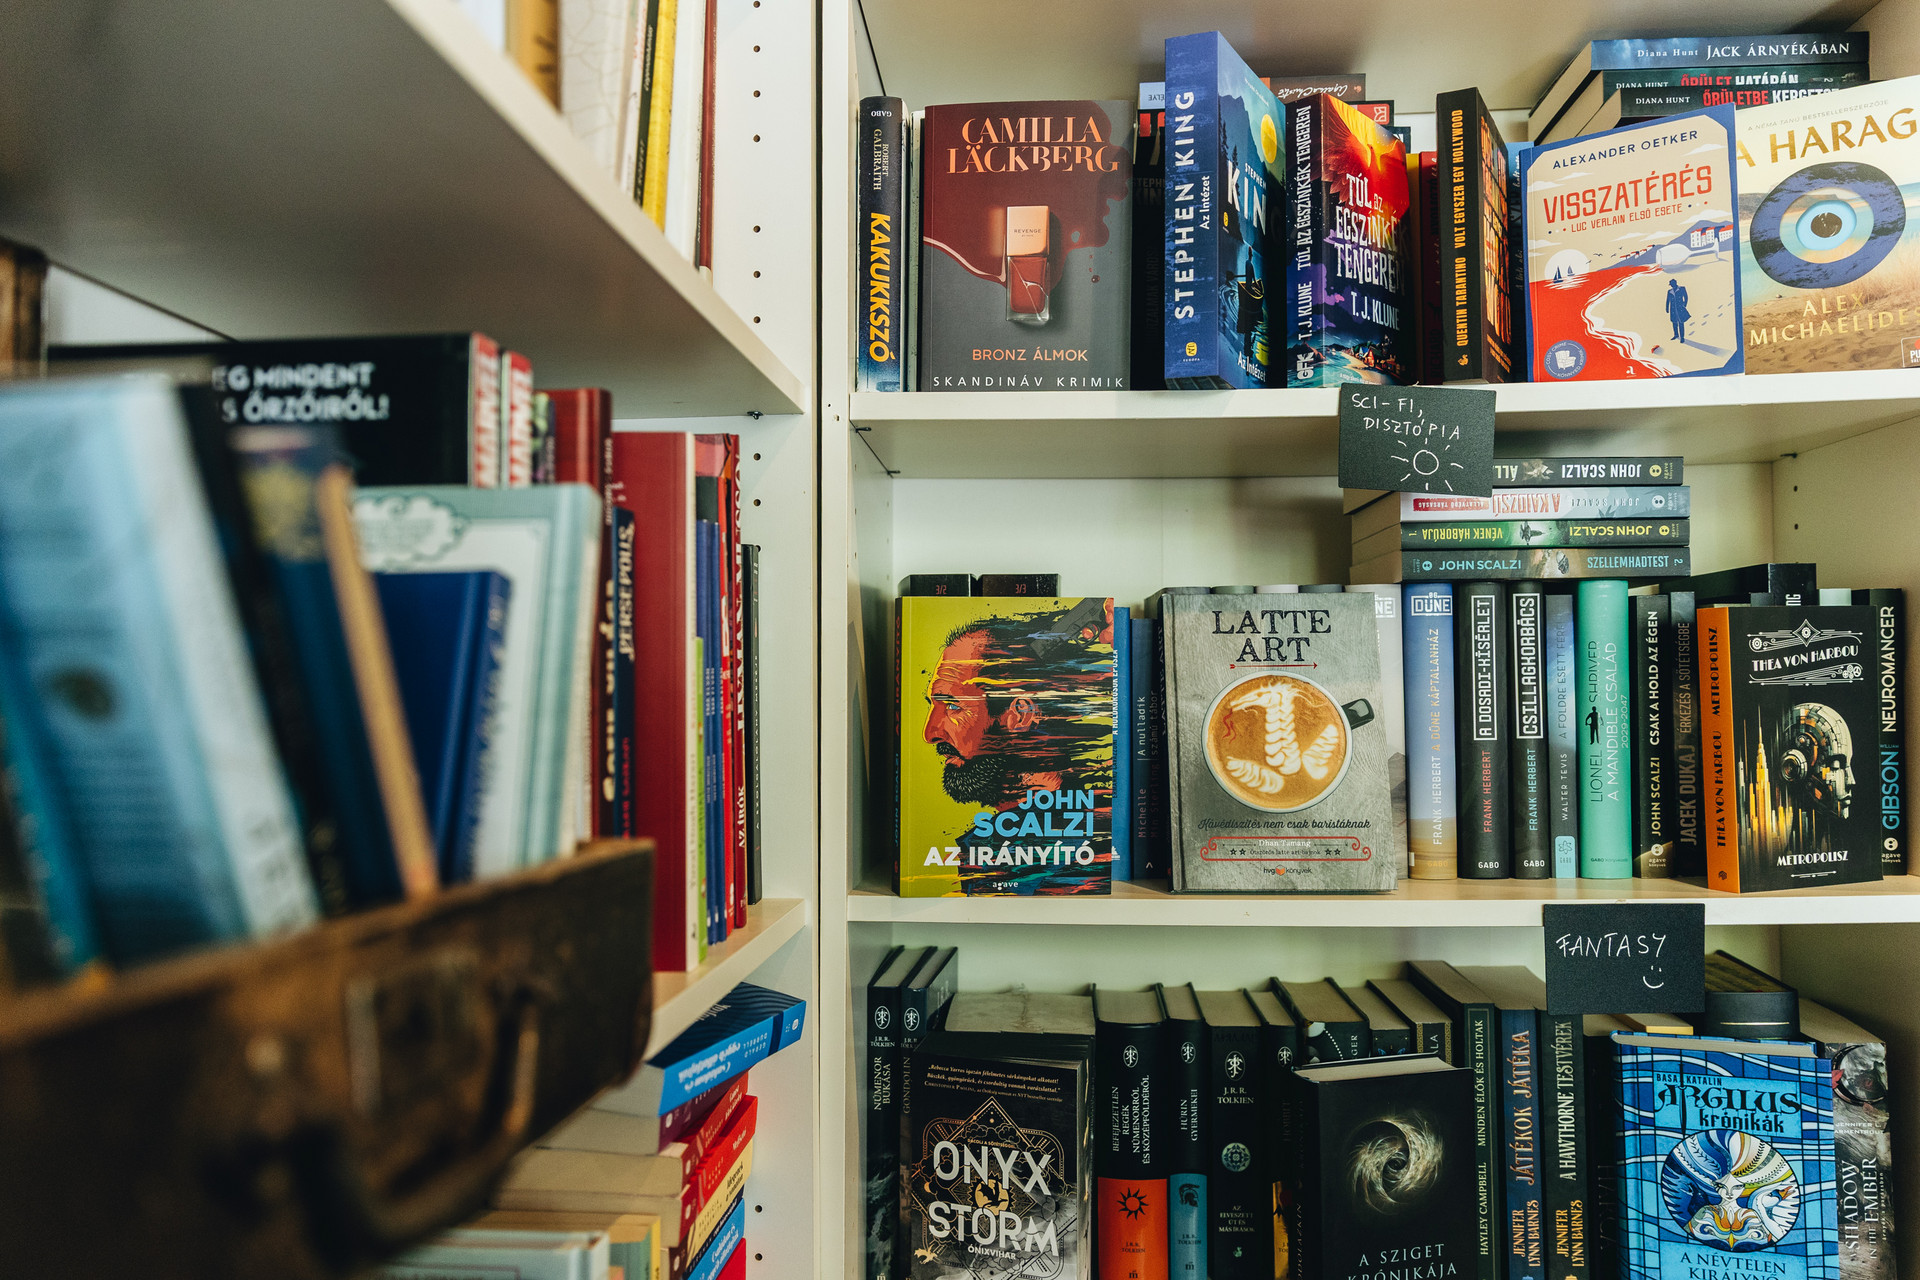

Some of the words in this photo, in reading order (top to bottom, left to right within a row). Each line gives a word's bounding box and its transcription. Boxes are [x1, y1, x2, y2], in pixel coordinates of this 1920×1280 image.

[1637, 50, 1668, 58] Diana
[1673, 48, 1699, 56] Hunt
[1706, 44, 1741, 61] JACK
[1747, 41, 1850, 57] ÁRNYÉKÁBAN
[1665, 96, 1690, 104] HUNT
[961, 116, 1103, 143] CAMILLA
[1174, 91, 1194, 167] KING
[1296, 105, 1312, 163] TENGEREN
[1451, 109, 1464, 163] HOLLYWOOD
[1769, 107, 1918, 164] HARAG
[873, 129, 882, 190] GALBRAITH
[947, 142, 1120, 173] LÄCKBERG
[1552, 142, 1636, 170] ALEXANDER
[1642, 129, 1698, 152] OETKER
[1346, 173, 1372, 208] TÚL
[1453, 165, 1464, 183] EGY
[1199, 175, 1210, 212] Intézet
[1294, 163, 1312, 229] ÉGSZÍNKÉK
[1453, 185, 1465, 224] EGYSZER
[1543, 163, 1713, 224] VISSZATÉRÉS
[1200, 213, 1210, 230] Az
[1571, 220, 1588, 233] LUC
[1590, 213, 1626, 230] VERLAIN
[1655, 202, 1683, 218] ESETE
[1174, 183, 1194, 319] STEPHEN
[1454, 225, 1466, 248] VOLT
[1296, 247, 1312, 270] TÚL
[870, 212, 895, 362] KAKUKKSZÓ
[1298, 281, 1312, 315] KLUNE
[1455, 257, 1467, 306] TARANTINO
[1372, 299, 1400, 331] KLUNE
[1803, 292, 1864, 317] ALEX
[1456, 308, 1468, 346] QUENTIN
[1750, 306, 1920, 346] MICHAELIDES
[972, 348, 1027, 361] BRONZ
[1034, 346, 1088, 362] ÁLMOK
[253, 362, 375, 388] MINDENT
[933, 375, 1044, 387] SKANDINÁV
[1057, 376, 1124, 388] KRIMIK
[1363, 417, 1460, 440] DISZTÓPIA
[1561, 464, 1606, 478] SCALZI
[1610, 464, 1641, 478] JOHN
[1493, 493, 1549, 517] KAIDZSÚ
[1422, 528, 1471, 542] HÁBORÚJA
[1473, 528, 1503, 542] VÉNEK
[1569, 526, 1614, 536] SCALZI
[1616, 525, 1652, 535] JOHN
[1439, 560, 1475, 571] JOHN
[1477, 559, 1521, 570] SCALZI
[1587, 556, 1669, 569] SZELLEMHADTEST
[1212, 609, 1332, 634] LATTE
[1646, 611, 1658, 643] ÉGEN
[1236, 636, 1311, 662] ART
[1475, 600, 1491, 722] DOSADI-KÍSÉRLET
[1518, 598, 1538, 734] CSILLAGKORBÁCS
[1649, 647, 1658, 662] AZ
[1676, 622, 1690, 680] SÖTÉTSÉGBE
[1752, 658, 1782, 672] THEA
[1784, 653, 1809, 668] VON
[1811, 645, 1859, 663] HARBOU
[1427, 628, 1439, 707] KÁPTALANHÁZ
[1603, 642, 1617, 702] CSALÁD
[1649, 665, 1659, 699] HOLD
[1708, 627, 1720, 716] METROPOLISZ
[1880, 606, 1897, 732] NEUROMANCER
[1137, 696, 1146, 746] nulladik
[1650, 713, 1660, 745] CSAK
[1677, 692, 1692, 733] ÉRKEZÉS
[1606, 707, 1618, 785] MANDIBLE
[1713, 731, 1723, 784] HARBOU
[1432, 756, 1441, 804] HERBERT
[1481, 750, 1491, 794] HERBERT
[1527, 748, 1537, 793] HERBERT
[1560, 753, 1568, 779] TEVIS
[1590, 750, 1602, 802] LIONEL
[1651, 757, 1660, 798] SCALZI
[1679, 745, 1696, 795] DUKAJ
[1018, 789, 1095, 810] JOHN
[1561, 784, 1569, 821] WALTER
[1608, 791, 1618, 801] A
[1716, 787, 1724, 814] VON
[1881, 751, 1900, 830] GIBSON
[973, 812, 1095, 837] SCALZI
[1264, 821, 1285, 829] nem
[1286, 818, 1309, 829] csak
[1311, 818, 1371, 829] baristáknak
[1433, 809, 1442, 845] FRANK
[1483, 799, 1493, 833] FRANK
[1529, 797, 1538, 831] FRANK
[1651, 802, 1661, 836] JOHN
[1680, 800, 1696, 845] JACEK
[1717, 818, 1726, 848] THEA
[924, 846, 961, 866] AZ
[970, 840, 1095, 866] IRÁNYÍTÓ
[1478, 861, 1499, 869] GABO
[1777, 851, 1848, 866] METROPOLISZ
[992, 881, 1019, 890] agave
[1263, 867, 1276, 876] hvg
[1556, 933, 1666, 958] FANTASY
[1475, 1020, 1484, 1059] HOLTAK
[1551, 1021, 1574, 1090] TESTVÉREK
[1506, 1030, 1533, 1099] JÁTÉKA
[1656, 1073, 1678, 1082] BASA
[1686, 1076, 1722, 1086] KATALIN
[873, 1056, 882, 1111] NÚMENOR
[882, 1063, 891, 1104] BUKÁSA
[902, 1057, 911, 1114] GONDOLIN
[1217, 1096, 1254, 1104] TOLKIEN
[1475, 1077, 1485, 1102] ÉLŐK
[1112, 1086, 1121, 1152] BEFEJEZETLEN
[1122, 1105, 1130, 1135] REGÉK
[1132, 1087, 1141, 1153] NÚMENORRÓL
[1140, 1075, 1150, 1150] KÖZÉPFÖLDÉRŐL
[1180, 1099, 1188, 1130] HÚRIN
[1190, 1088, 1198, 1142] GYERMEKEI
[1477, 1106, 1486, 1147] MINDEN
[1700, 1108, 1784, 1133] krónikák
[1508, 1106, 1534, 1186] JÁTÉKOK
[1557, 1092, 1576, 1169] HAWTHORNE
[933, 1140, 1051, 1196] ONYX
[1478, 1162, 1488, 1215] CAMPBELL
[1842, 1160, 1860, 1251] SHADOW
[1862, 1156, 1880, 1223] EMBER
[928, 1201, 1059, 1257] STORM
[1480, 1217, 1489, 1255] HAYLEY
[1512, 1209, 1526, 1257] JENNIFER
[1526, 1200, 1540, 1239] BARNES
[1556, 1209, 1569, 1257] JENNIFER
[1570, 1200, 1584, 1240] BARNES
[967, 1244, 1016, 1260] ÓNIXVIHAR
[1359, 1254, 1369, 1267] A
[1380, 1243, 1445, 1265] SZIGET
[1528, 1242, 1541, 1267] LYNN
[1572, 1241, 1585, 1267] LYNN
[1681, 1252, 1695, 1264] A
[1697, 1252, 1786, 1275] NÉVTELEN
